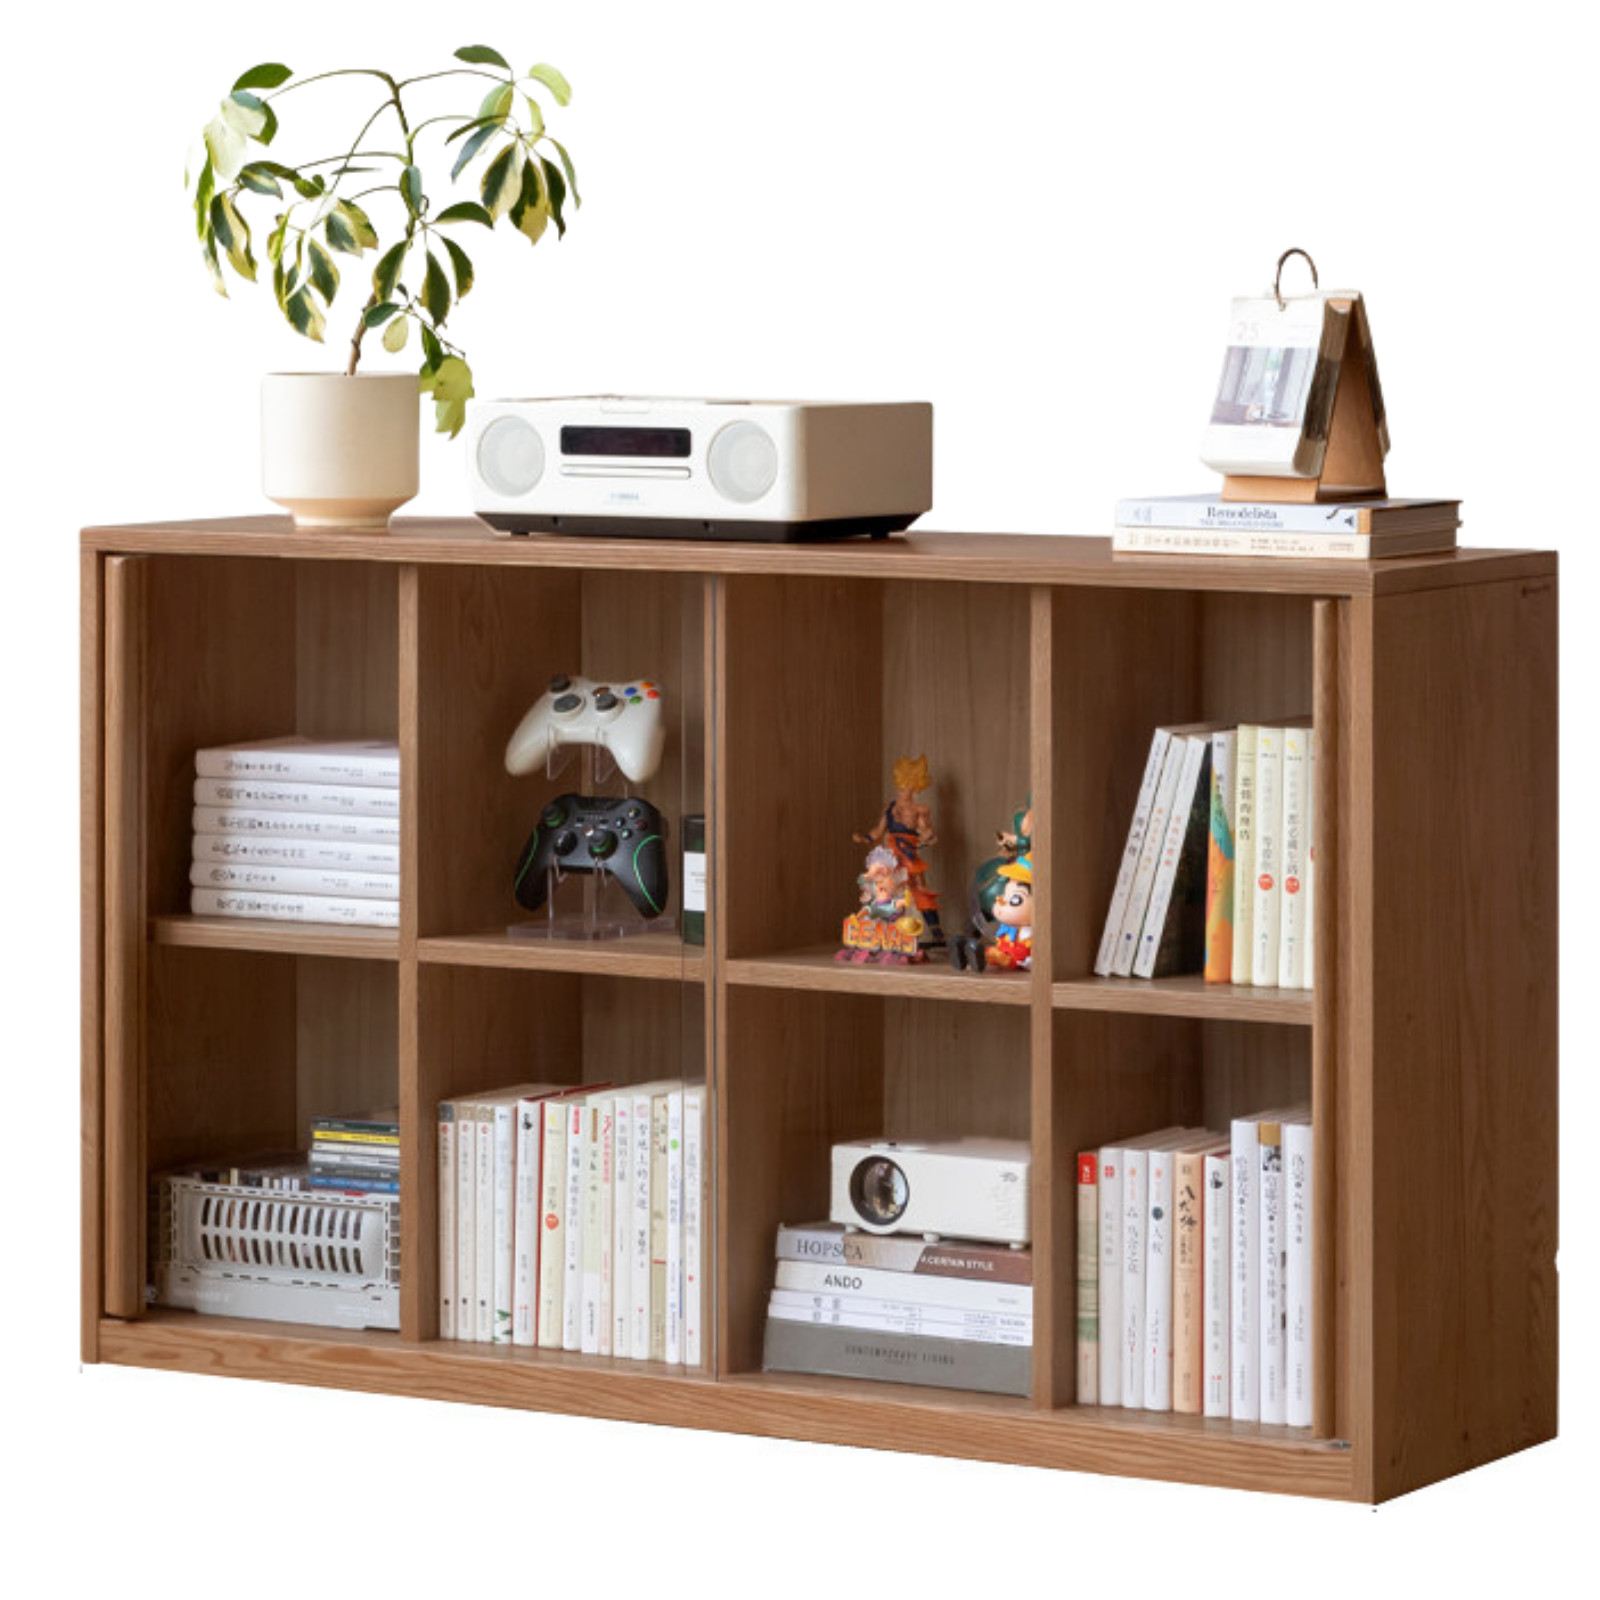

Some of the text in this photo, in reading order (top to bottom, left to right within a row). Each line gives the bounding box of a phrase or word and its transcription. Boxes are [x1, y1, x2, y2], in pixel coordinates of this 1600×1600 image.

[1207, 506, 1277, 520] Remodelista
[928, 1256, 965, 1269] CERTAIN
[966, 1259, 994, 1271] STYLE
[824, 1274, 862, 1289] ANDO
